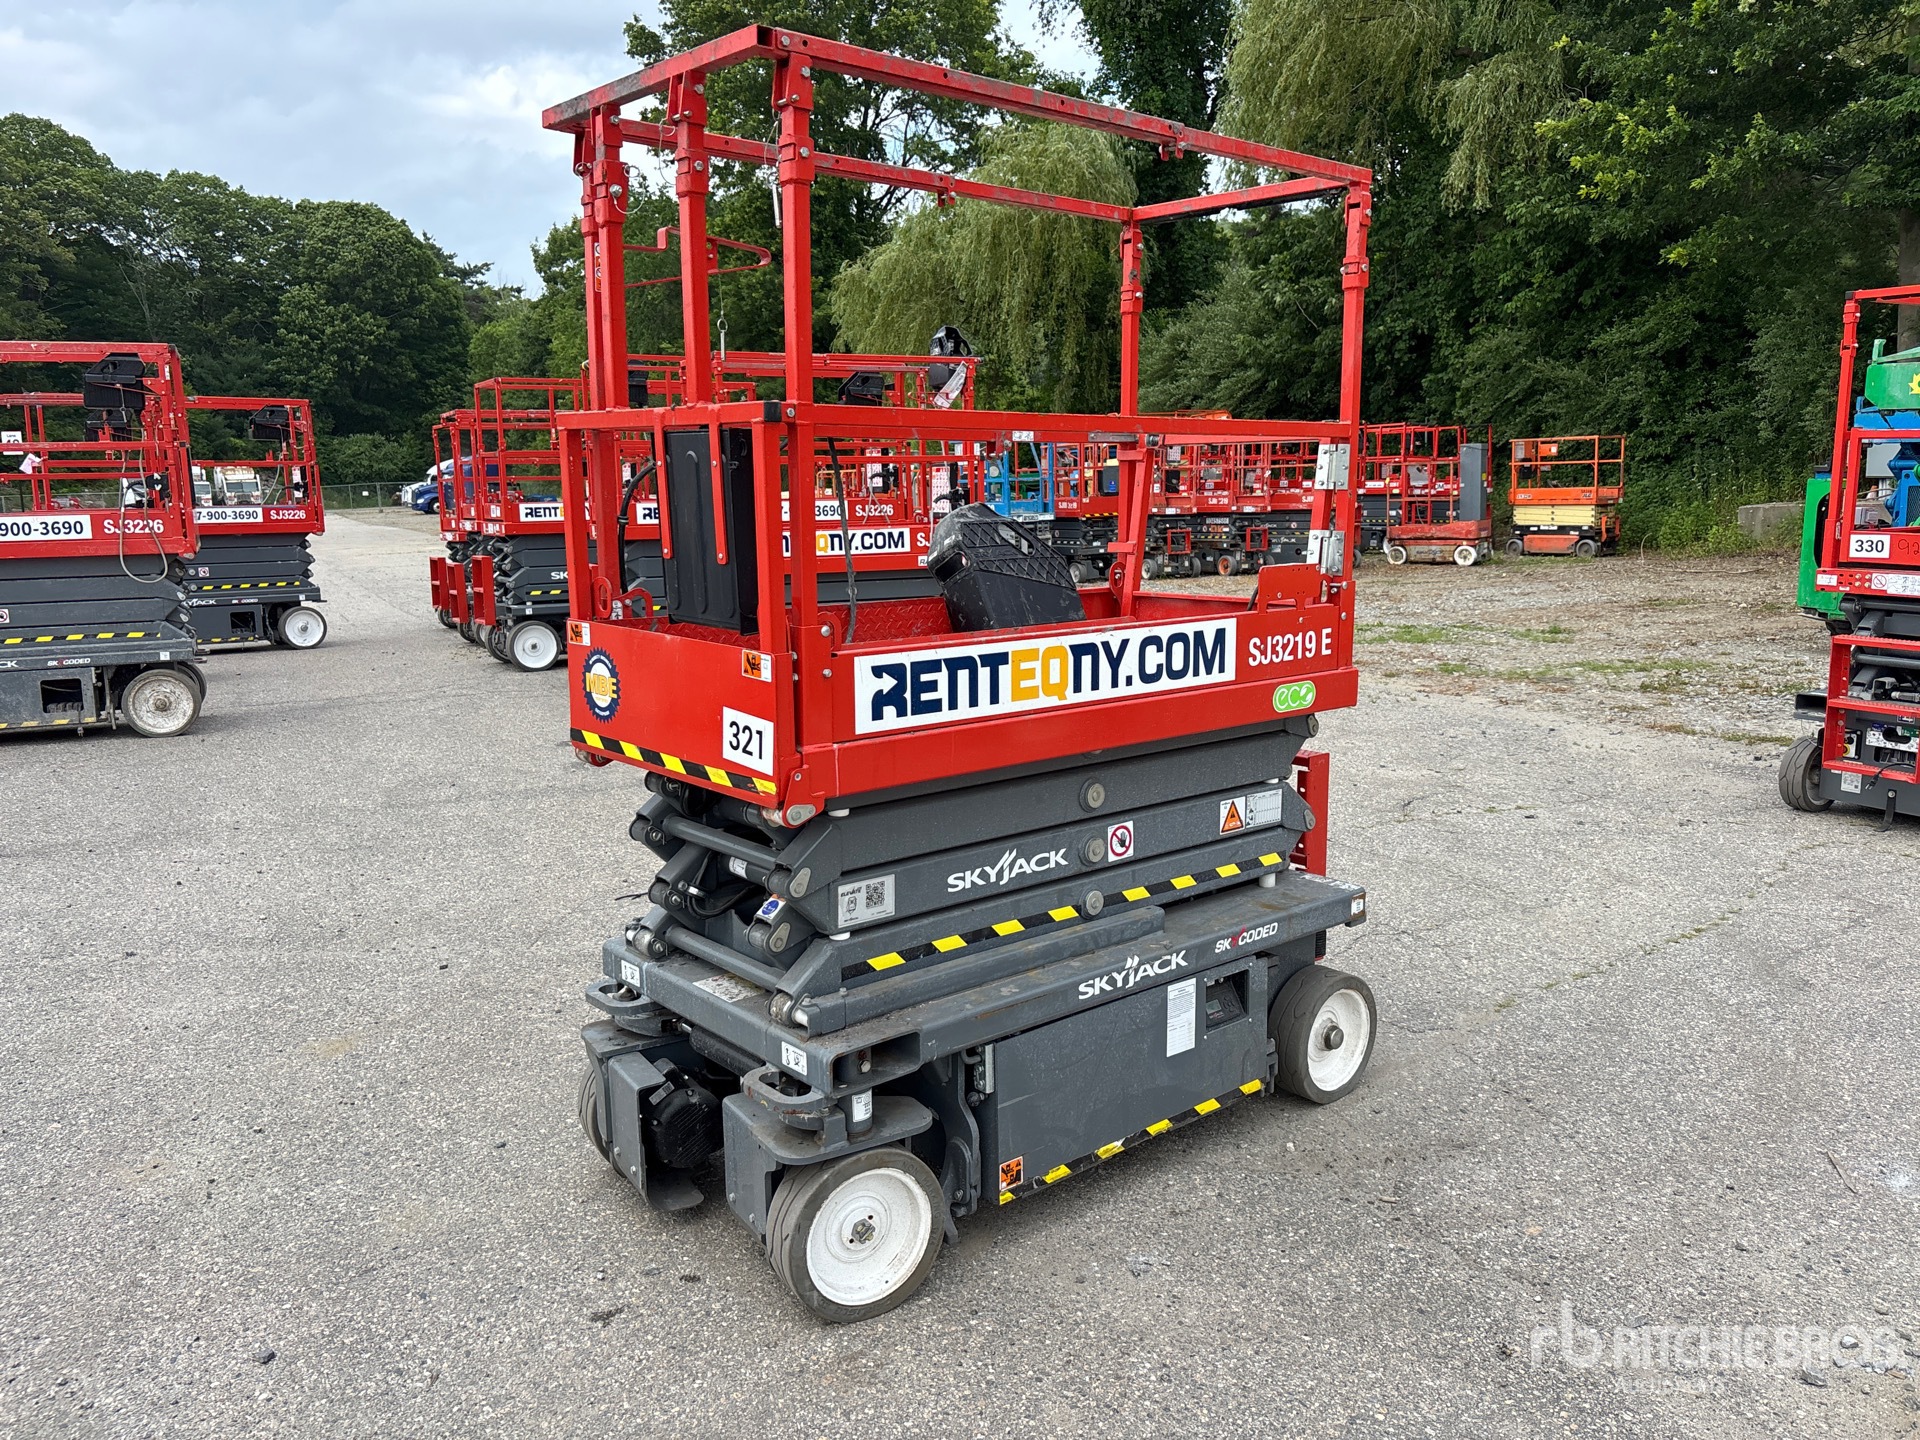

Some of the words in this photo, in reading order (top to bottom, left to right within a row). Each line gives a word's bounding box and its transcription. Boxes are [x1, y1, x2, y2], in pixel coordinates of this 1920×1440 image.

[270, 509, 306, 520] SJ3226
[855, 504, 894, 517] SJ3226
[103, 518, 164, 535] SJ3226
[1854, 539, 1885, 553] 330
[1248, 630, 1317, 667] SJ3219
[1321, 627, 1332, 656] E
[585, 672, 618, 699] MBE
[871, 627, 1226, 722] RENTEQNY.COM
[1276, 683, 1314, 709] eco
[728, 720, 763, 760] 321
[947, 848, 1069, 893] SKYJACK
[1078, 950, 1189, 1000] SKYJACK
